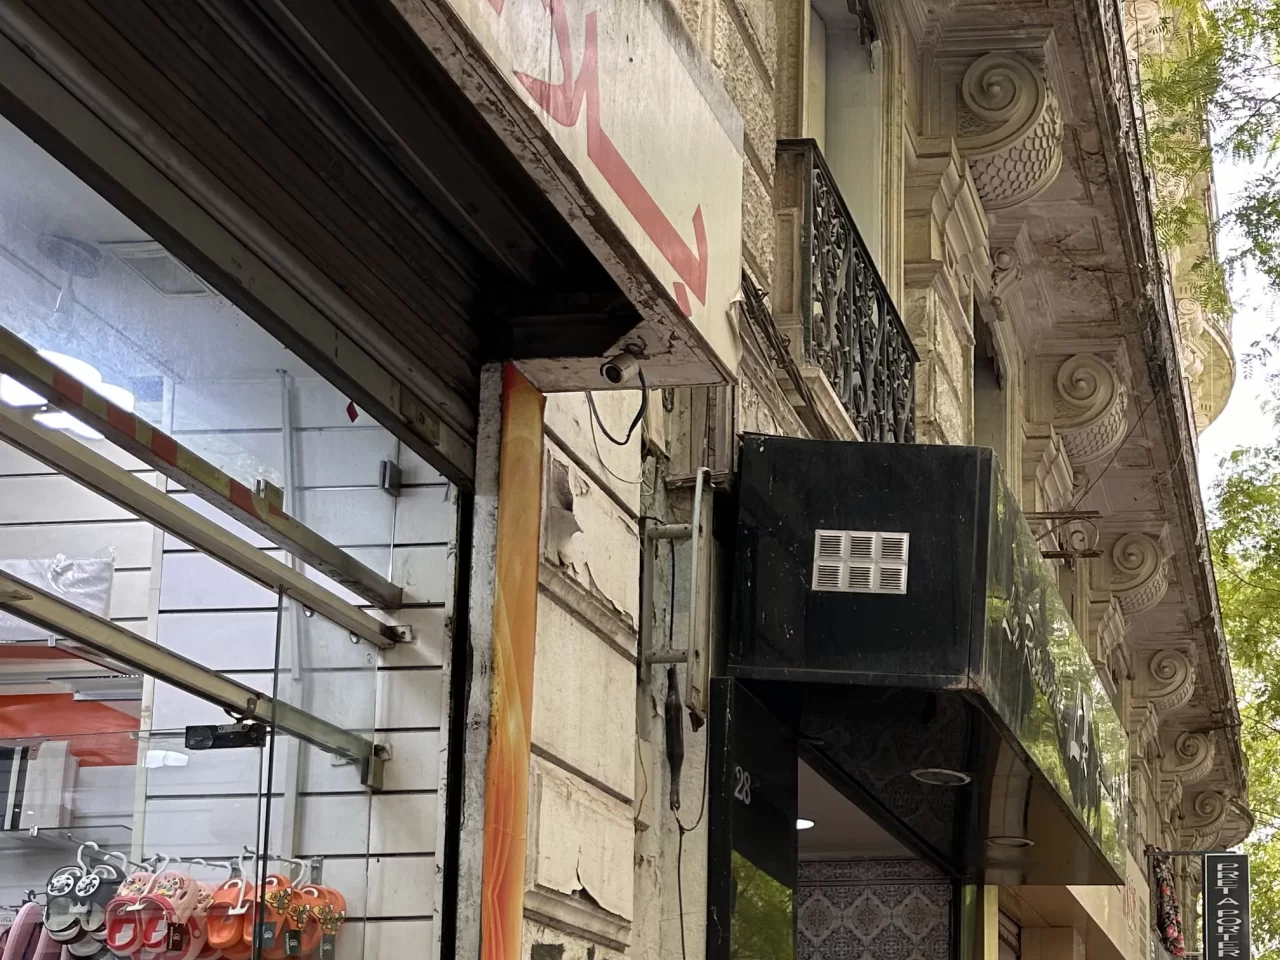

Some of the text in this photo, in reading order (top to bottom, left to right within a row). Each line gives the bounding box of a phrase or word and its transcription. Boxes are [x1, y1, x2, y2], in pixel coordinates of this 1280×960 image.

[734, 766, 751, 805] 28
[1214, 862, 1239, 894] PRET
[1215, 909, 1242, 957] PORTER
